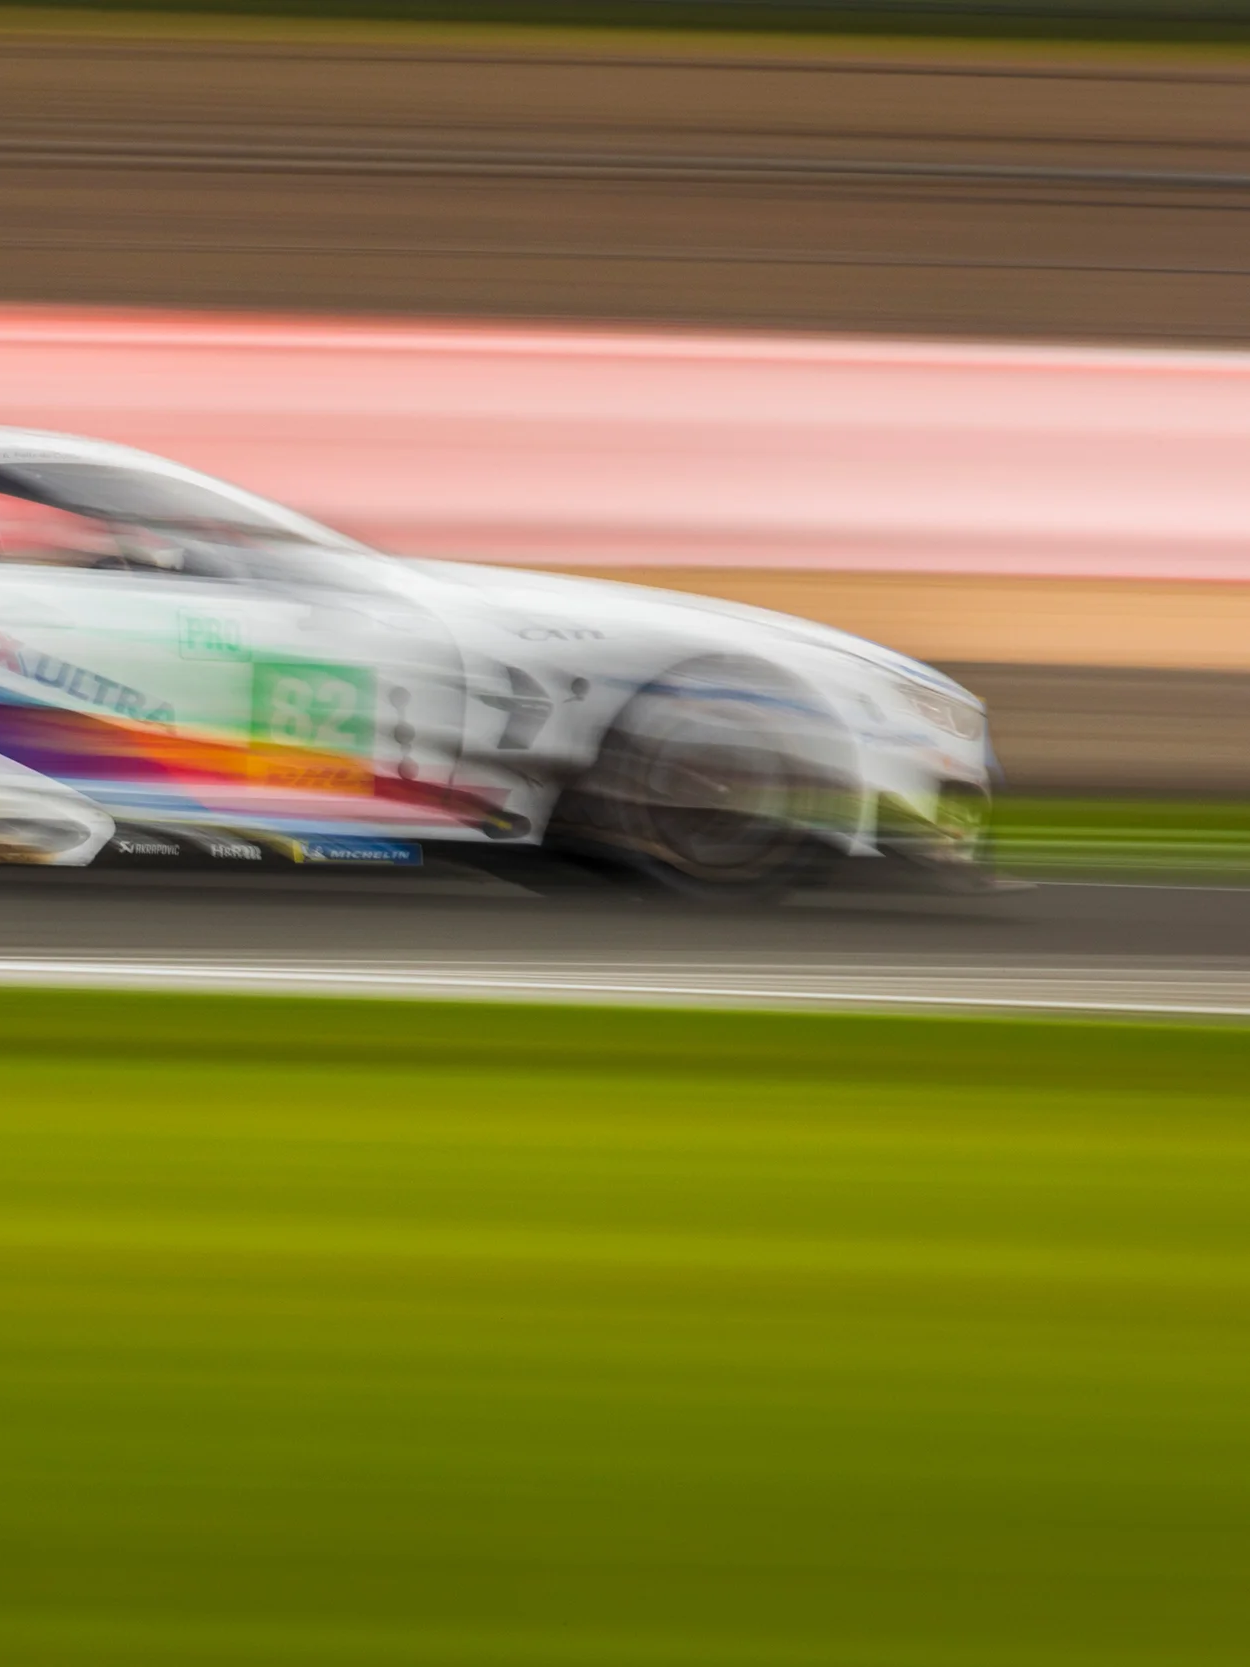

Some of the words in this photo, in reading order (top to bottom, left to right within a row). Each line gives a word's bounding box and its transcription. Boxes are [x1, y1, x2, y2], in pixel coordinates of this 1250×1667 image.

[186, 616, 241, 652] PRO
[30, 651, 177, 736] ULTRA
[270, 674, 358, 747] 82
[330, 849, 411, 860] MICHELIN
